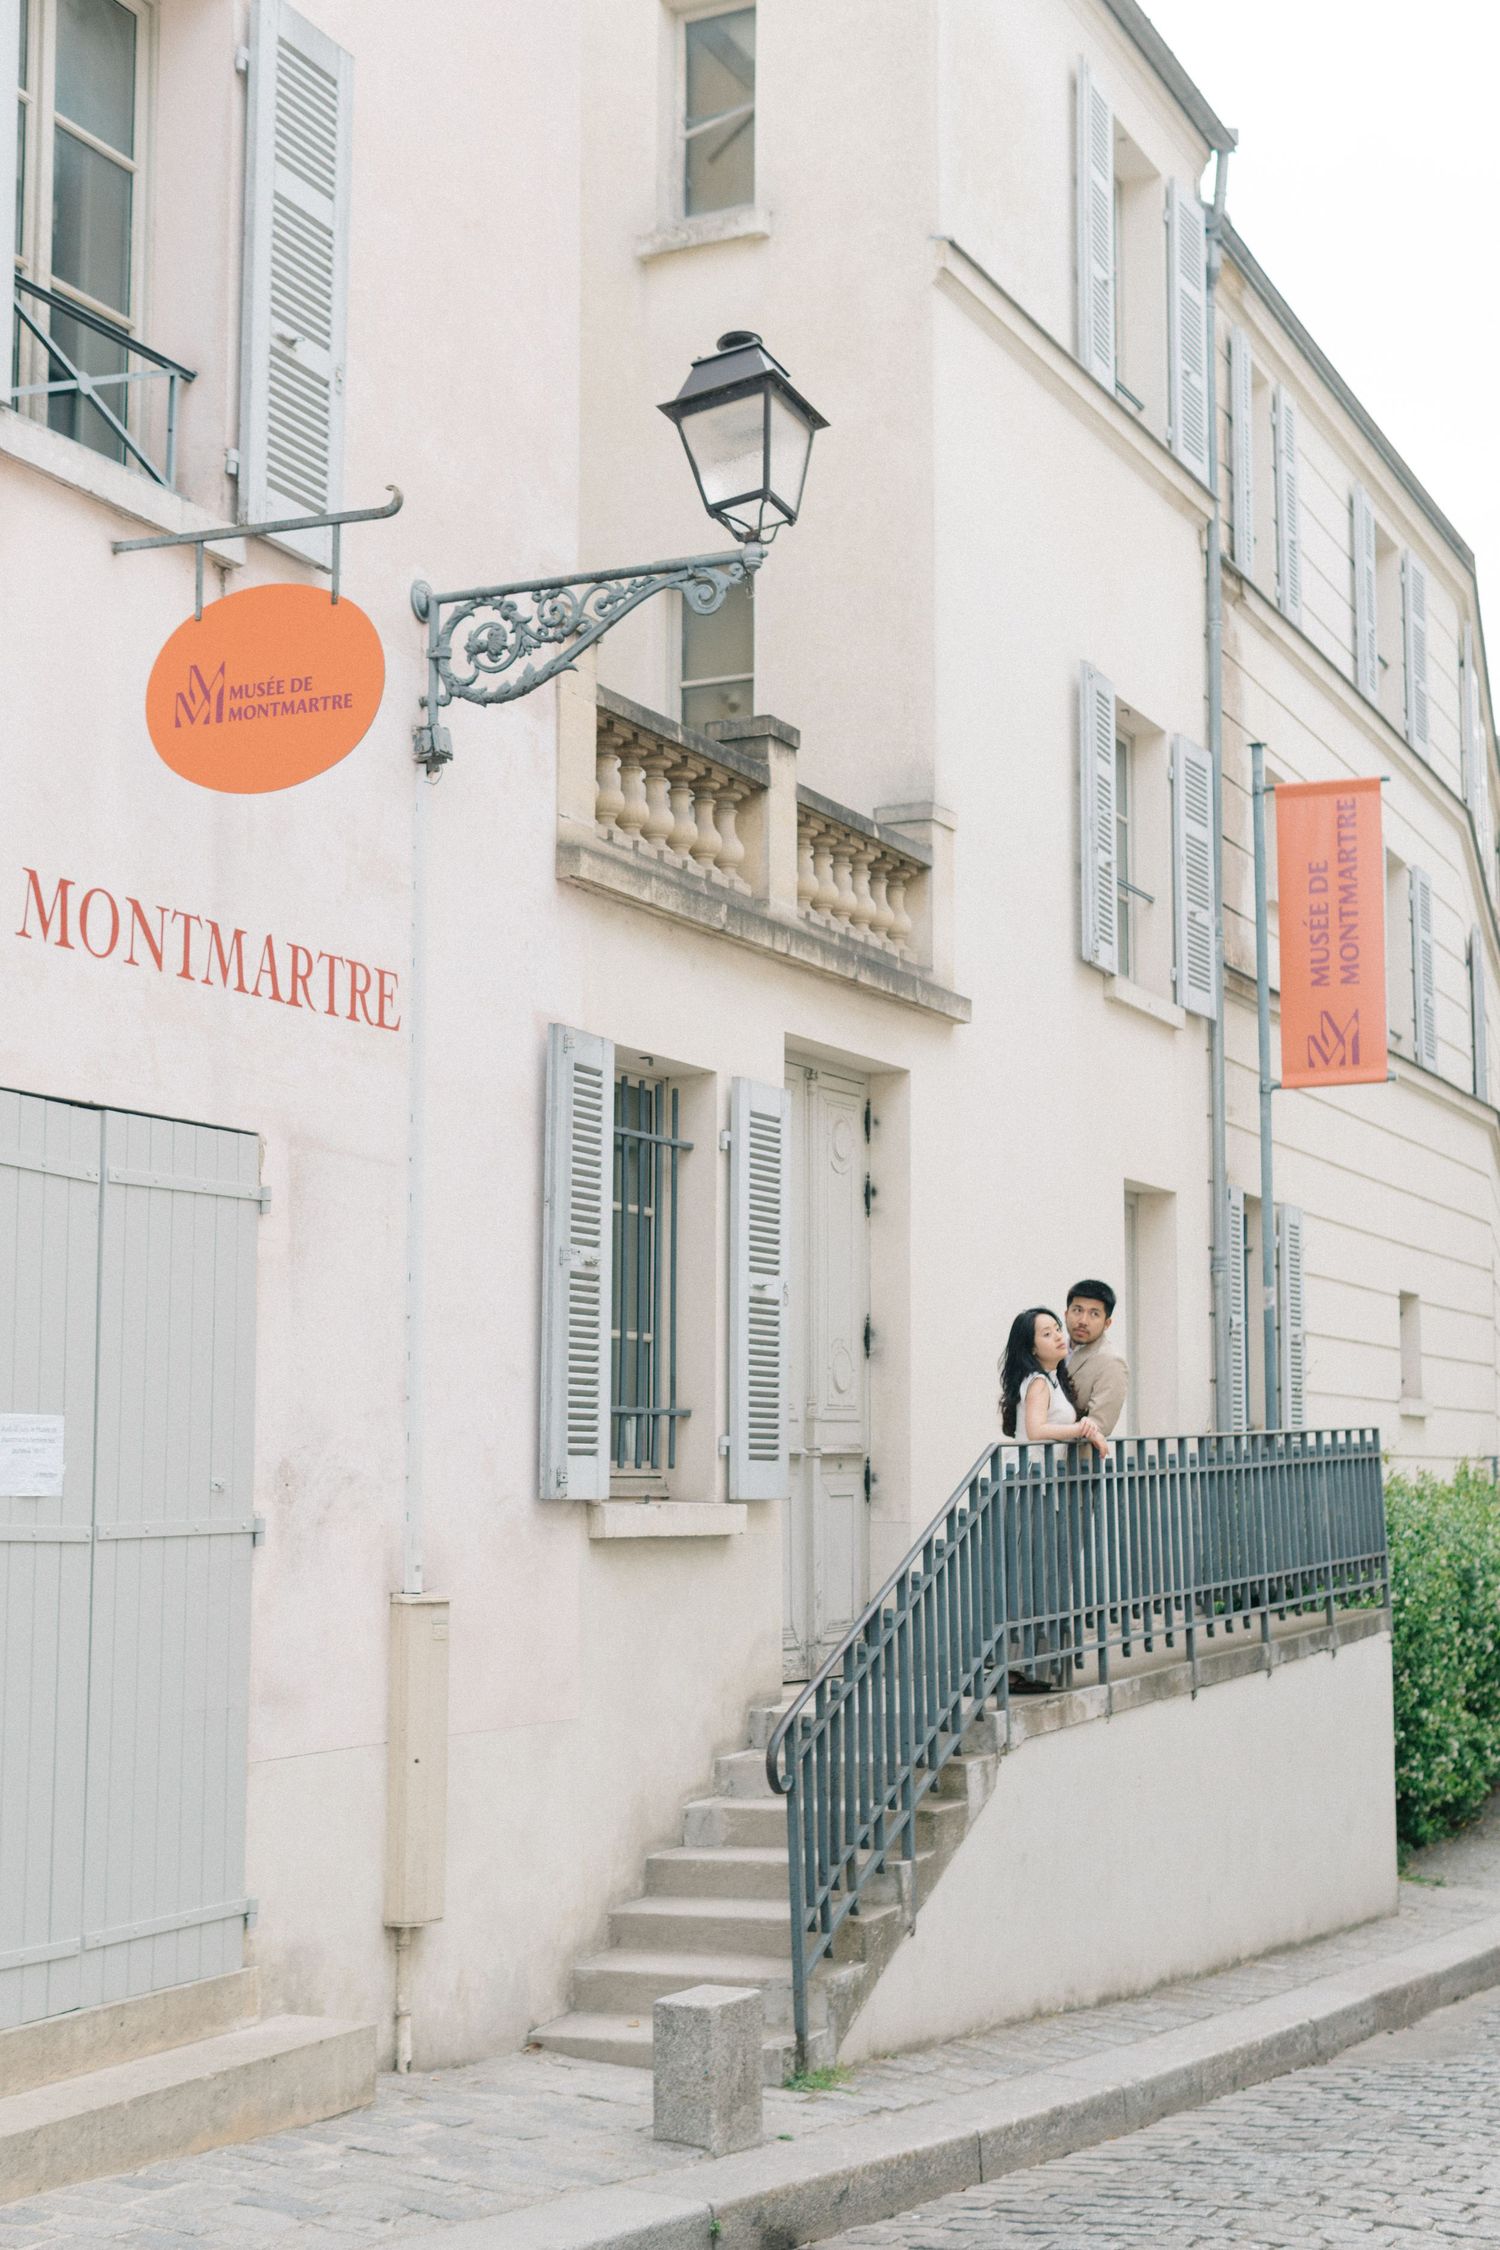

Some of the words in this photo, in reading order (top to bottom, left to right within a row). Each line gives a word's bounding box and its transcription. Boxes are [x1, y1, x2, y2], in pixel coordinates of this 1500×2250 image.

[228, 693, 353, 722] MONTMARTRE
[229, 676, 285, 701] MUSÉE
[290, 676, 313, 694] DE
[1308, 859, 1329, 895] DE
[1336, 797, 1361, 986] MONTMARTRE
[15, 867, 402, 1032] MONTMARTRE
[1303, 902, 1331, 988] MUSÉE
